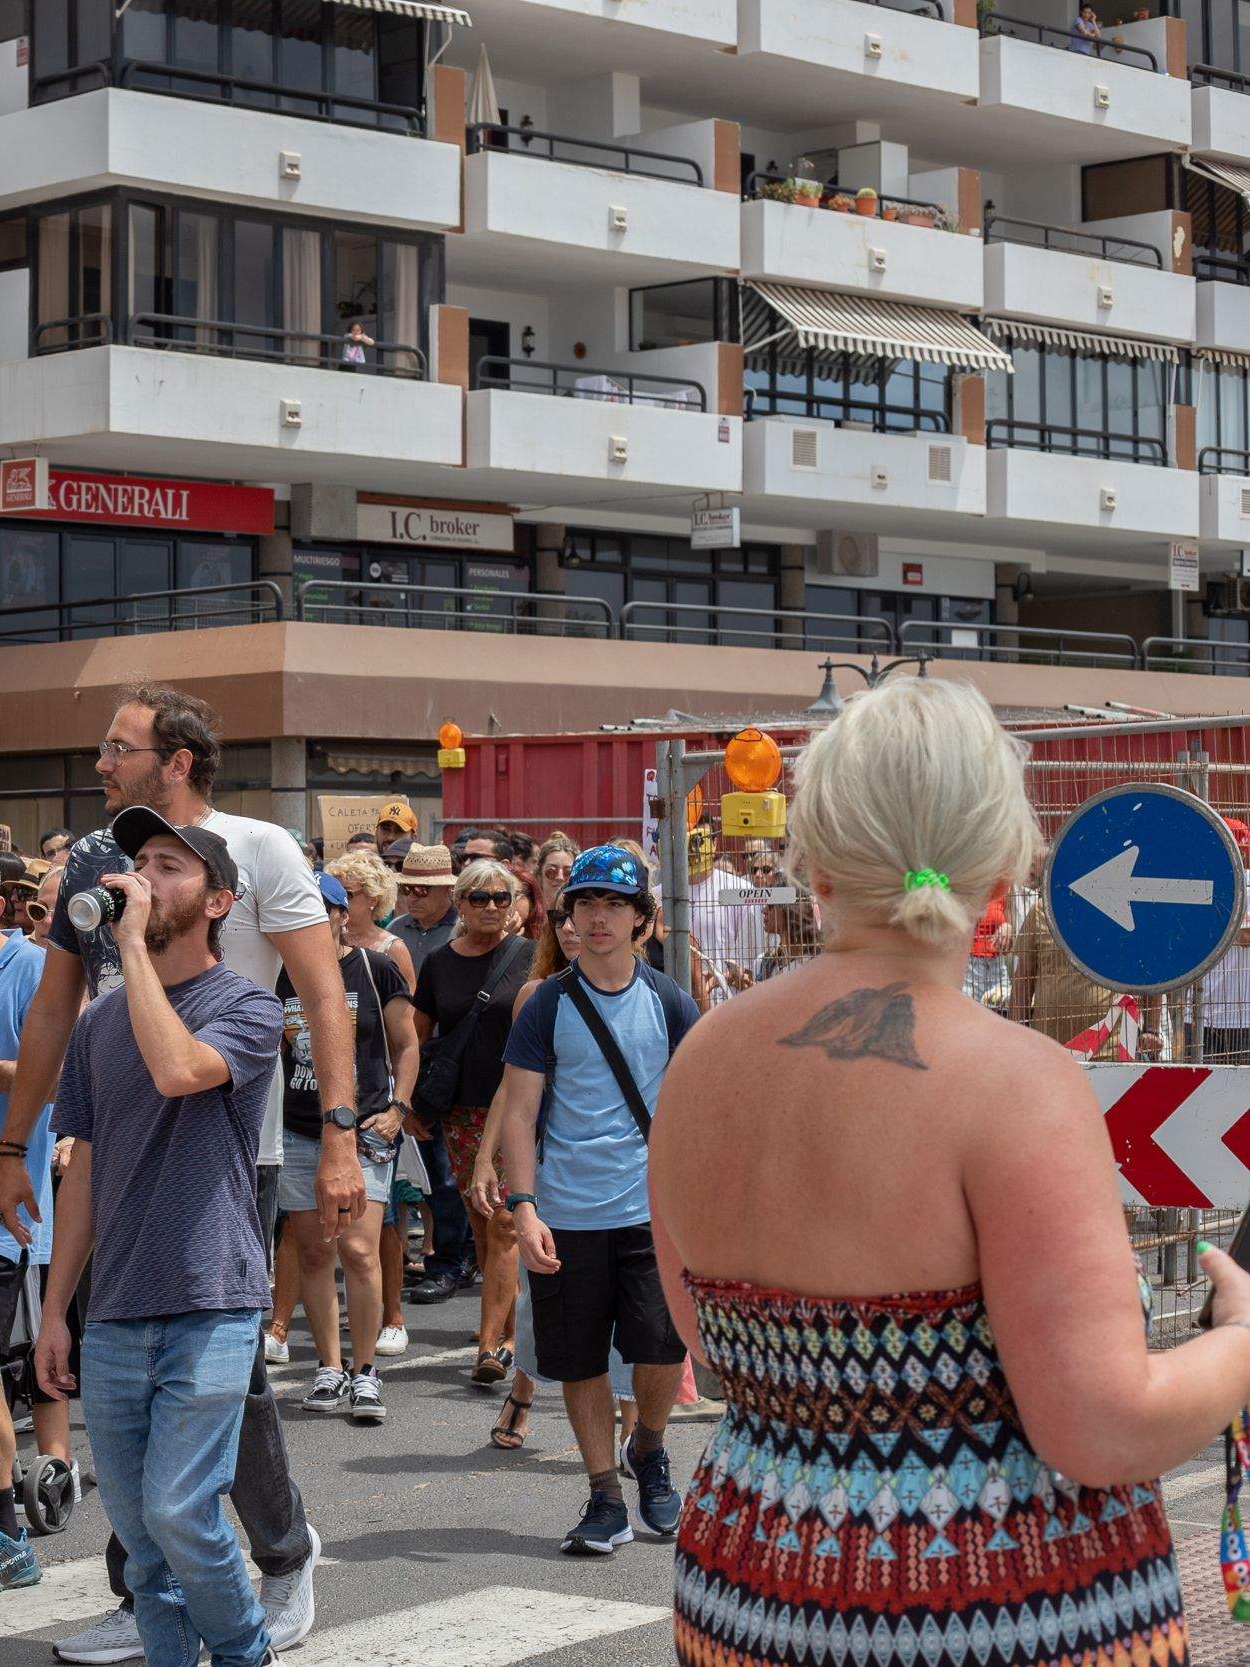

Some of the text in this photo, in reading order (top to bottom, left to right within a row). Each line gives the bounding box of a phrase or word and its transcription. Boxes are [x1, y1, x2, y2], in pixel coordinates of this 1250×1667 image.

[58, 479, 189, 520] GENERALI
[389, 510, 480, 542] I.C. broker
[468, 567, 510, 579] PERSONALES
[330, 807, 367, 817] CALETA
